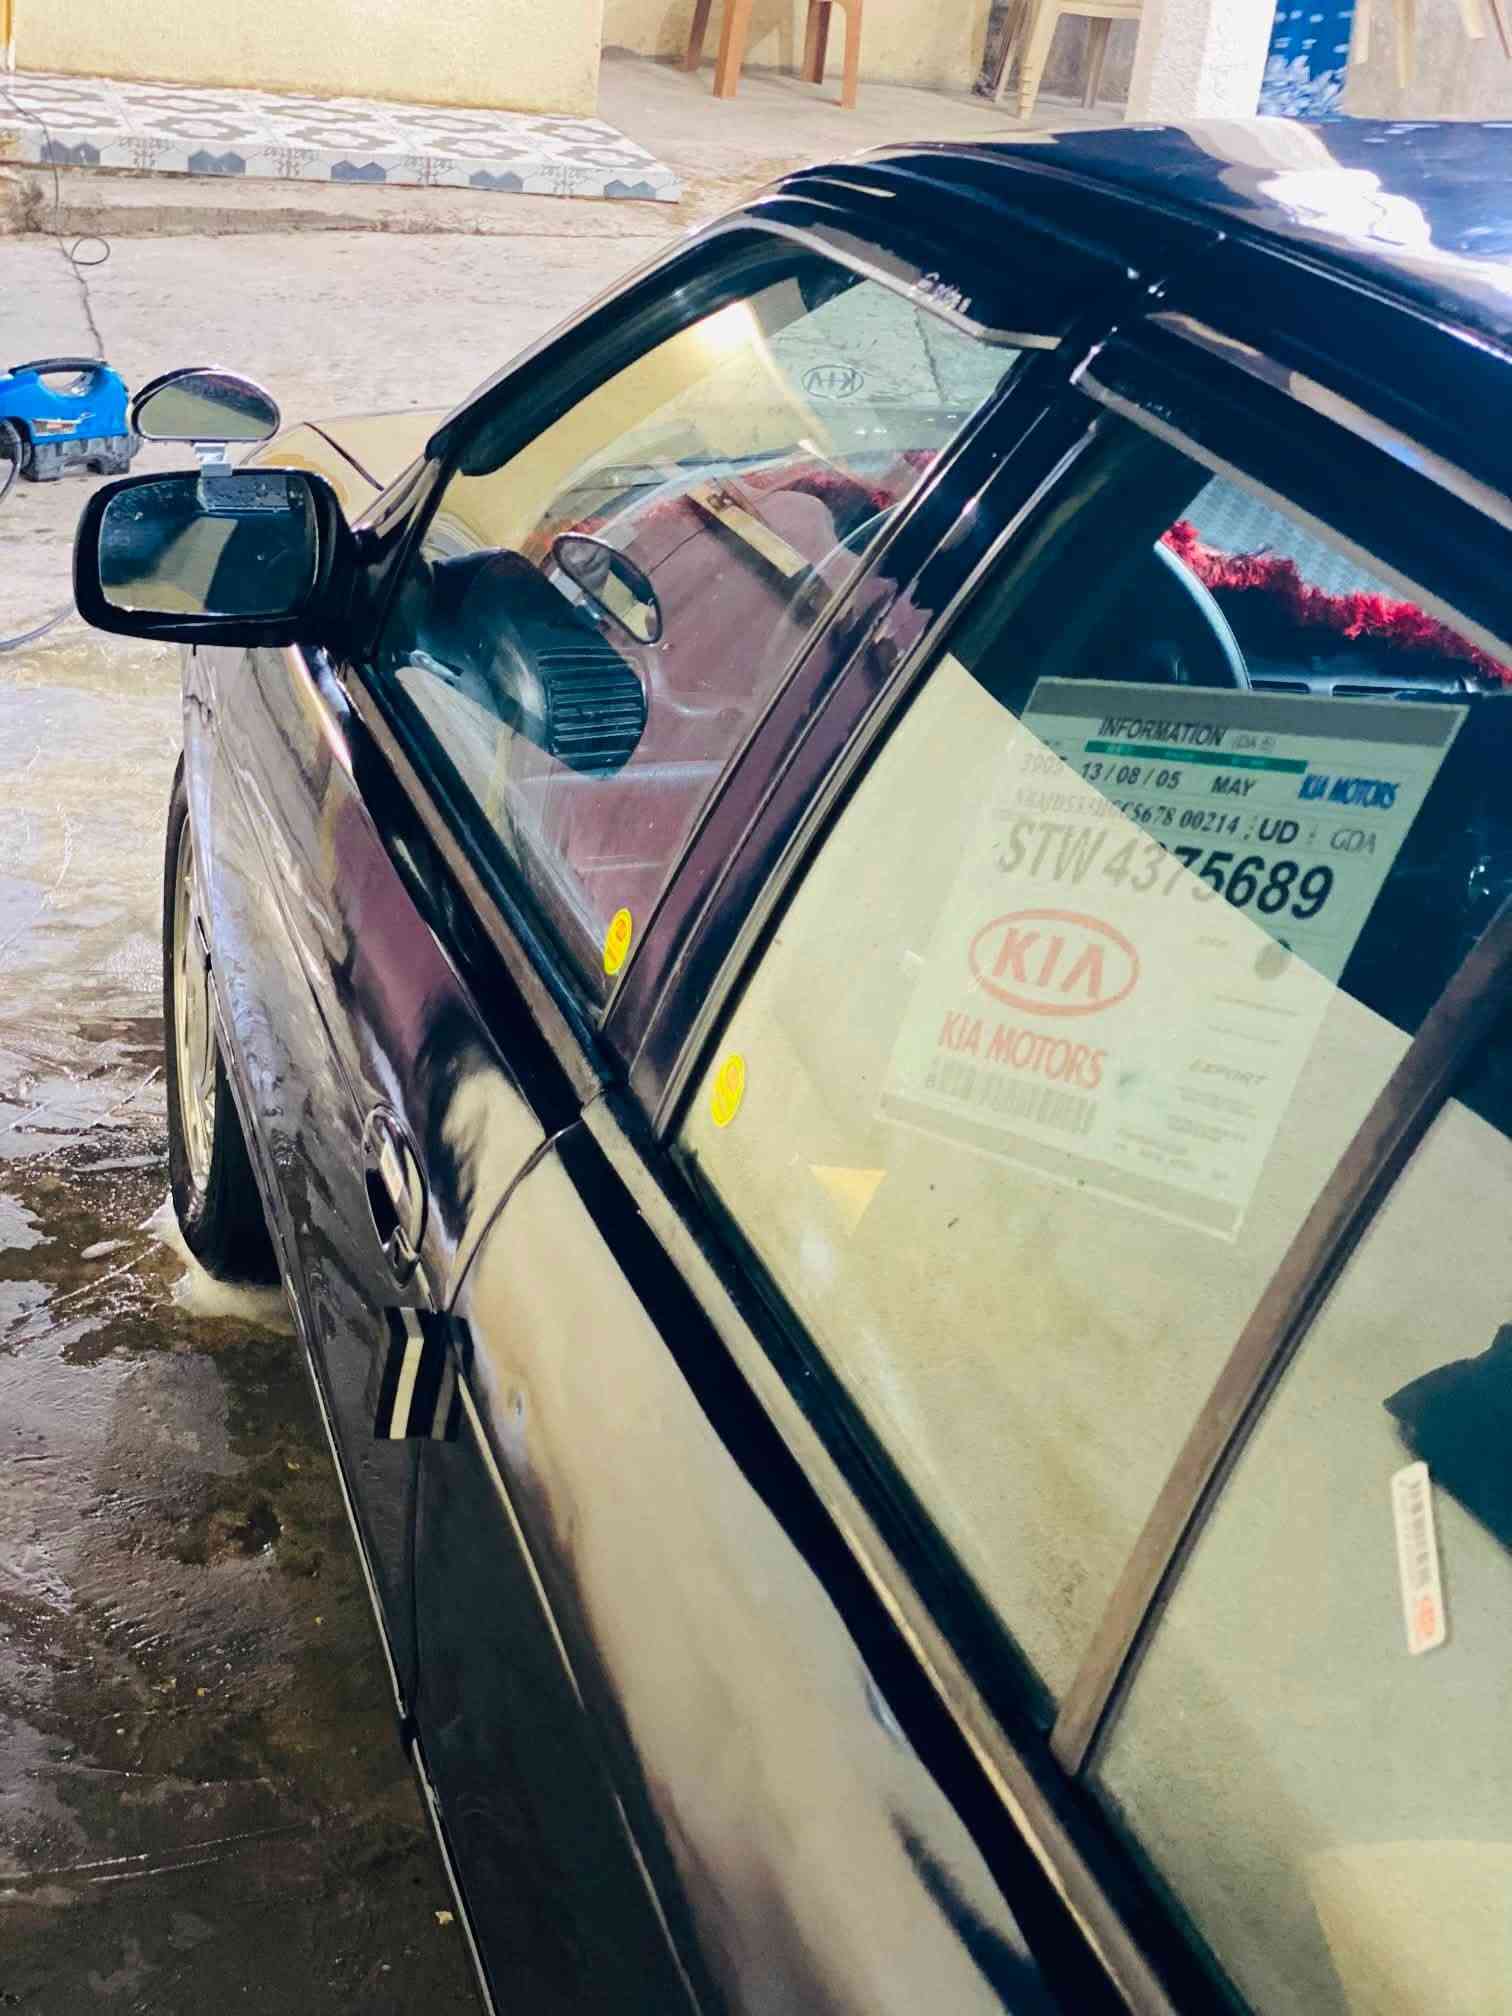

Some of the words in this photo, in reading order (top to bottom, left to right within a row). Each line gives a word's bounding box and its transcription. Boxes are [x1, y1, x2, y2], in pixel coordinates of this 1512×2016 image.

[1099, 716, 1229, 746] INFORMATION
[1210, 774, 1259, 797] MAY
[1258, 817, 1300, 844] UD
[996, 818, 1107, 883] STW
[1101, 838, 1336, 921] 4375689
[991, 926, 1106, 1001] KIA
[937, 1009, 984, 1056] KIA
[985, 1024, 1108, 1089] MOTORS
